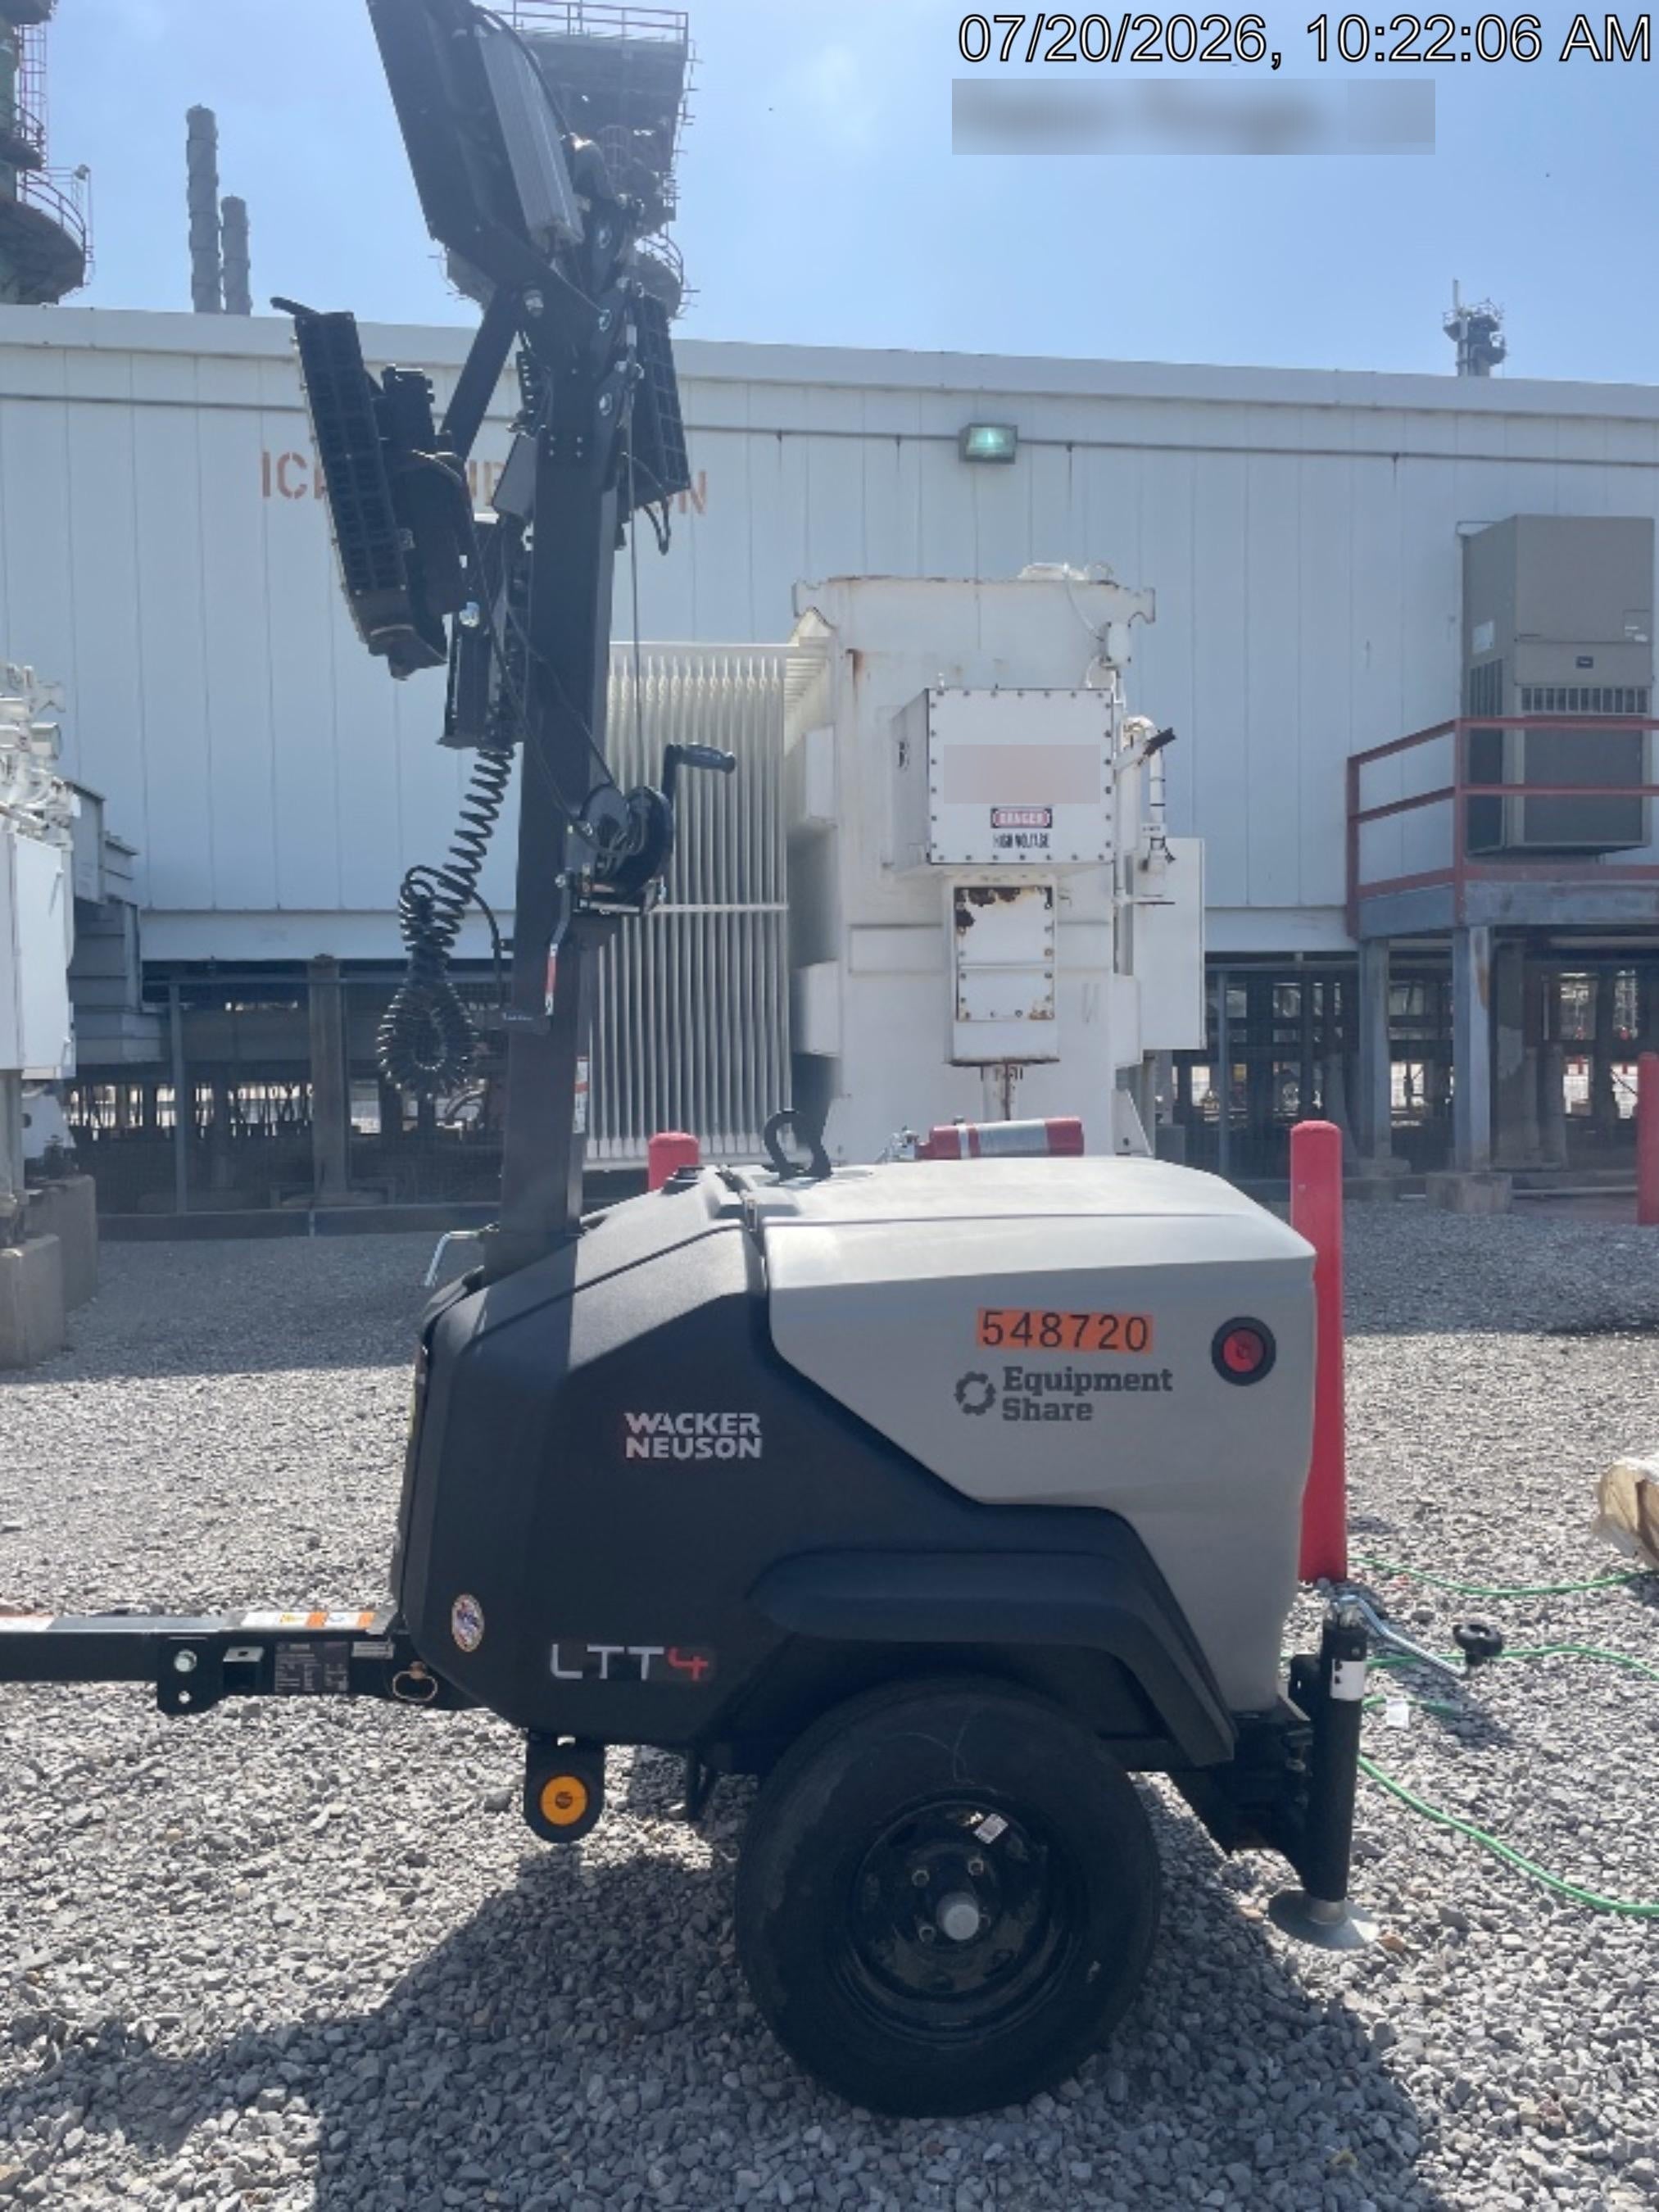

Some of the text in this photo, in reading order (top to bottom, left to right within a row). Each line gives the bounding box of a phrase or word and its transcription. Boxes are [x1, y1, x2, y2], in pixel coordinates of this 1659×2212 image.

[982, 1311, 1148, 1352] 548720
[1002, 1366, 1173, 1396] Equipment
[1002, 1397, 1093, 1421] Share
[623, 1412, 762, 1435] WACKER
[626, 1436, 762, 1460] NEUSON
[550, 1643, 709, 1682] LTT4
